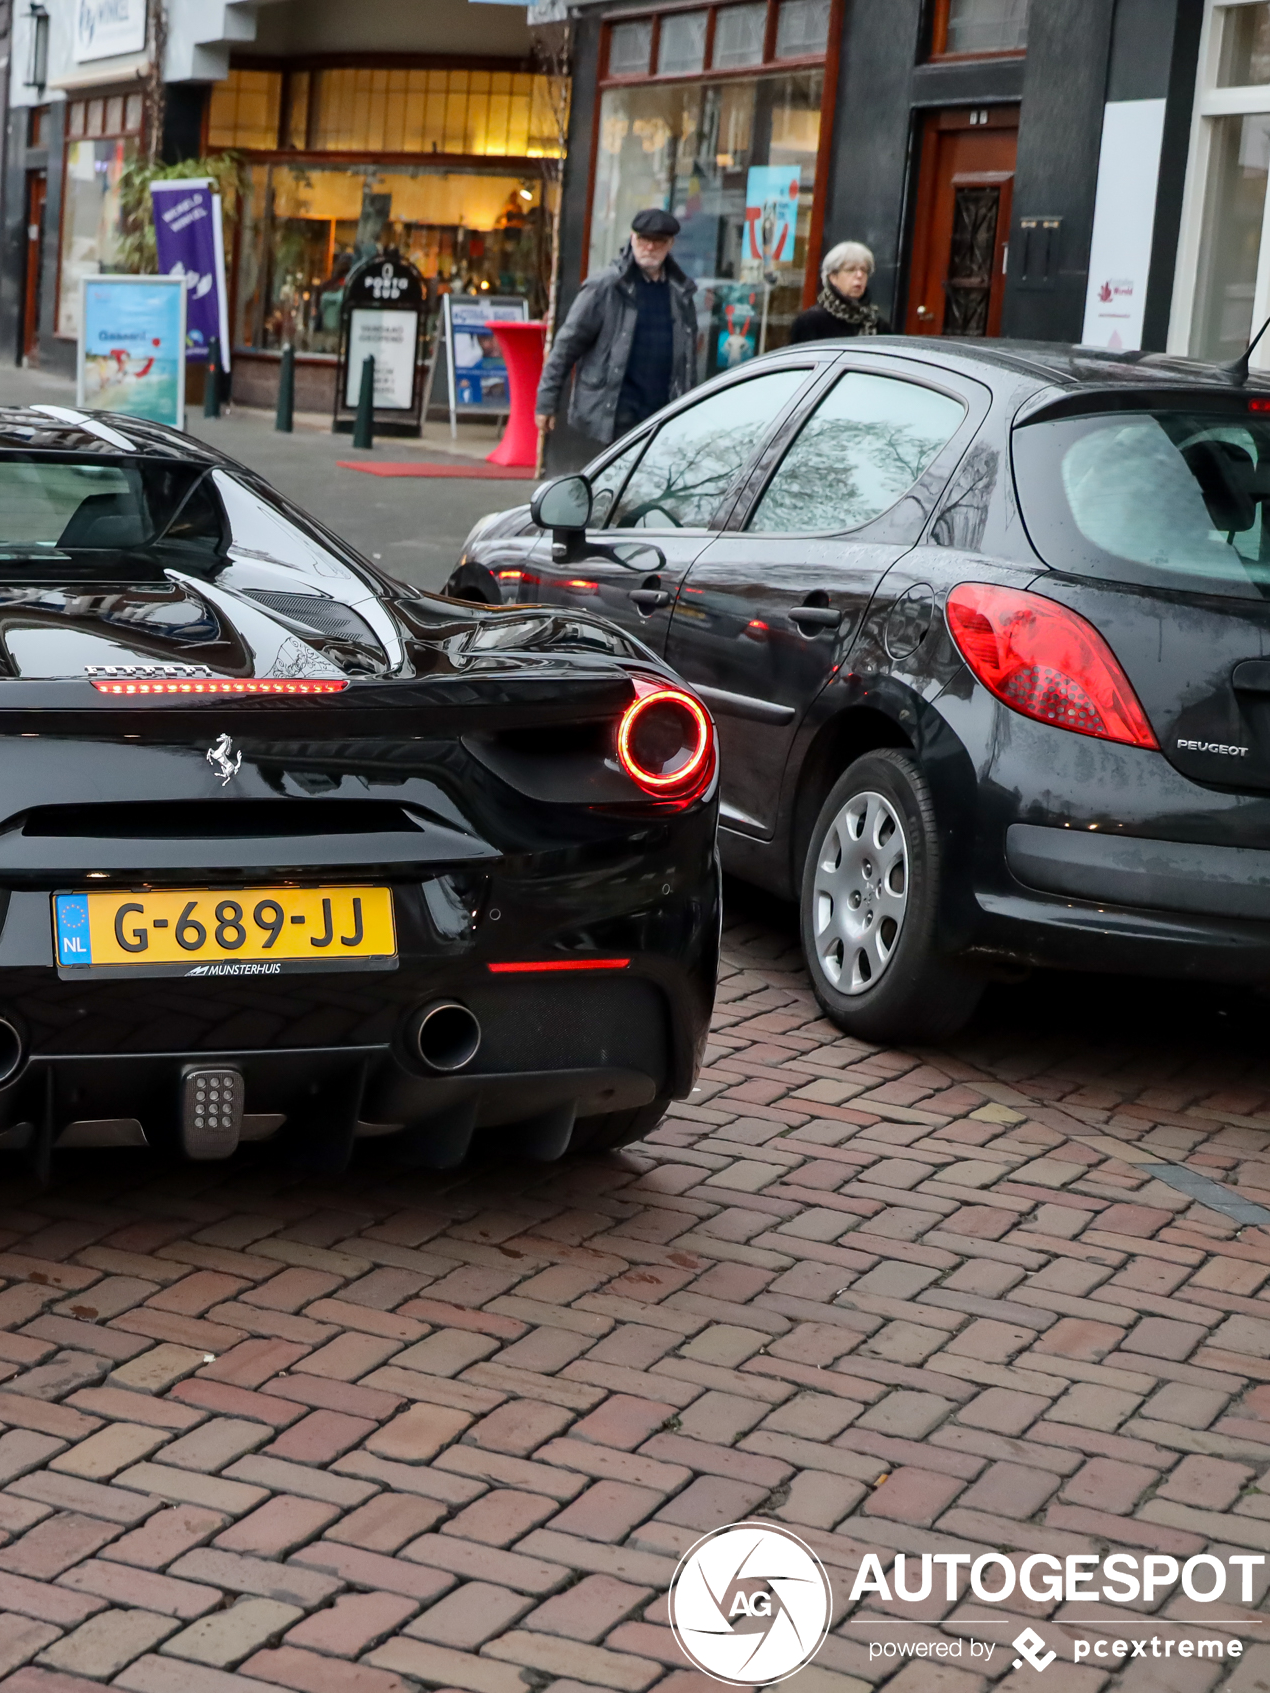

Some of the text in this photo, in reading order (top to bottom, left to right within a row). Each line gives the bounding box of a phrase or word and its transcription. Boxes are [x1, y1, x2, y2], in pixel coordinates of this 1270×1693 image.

[1177, 739, 1249, 757] PEUGEOT
[63, 898, 365, 953] NL G-689-JJ
[208, 963, 281, 976] MUNSTERHUIS
